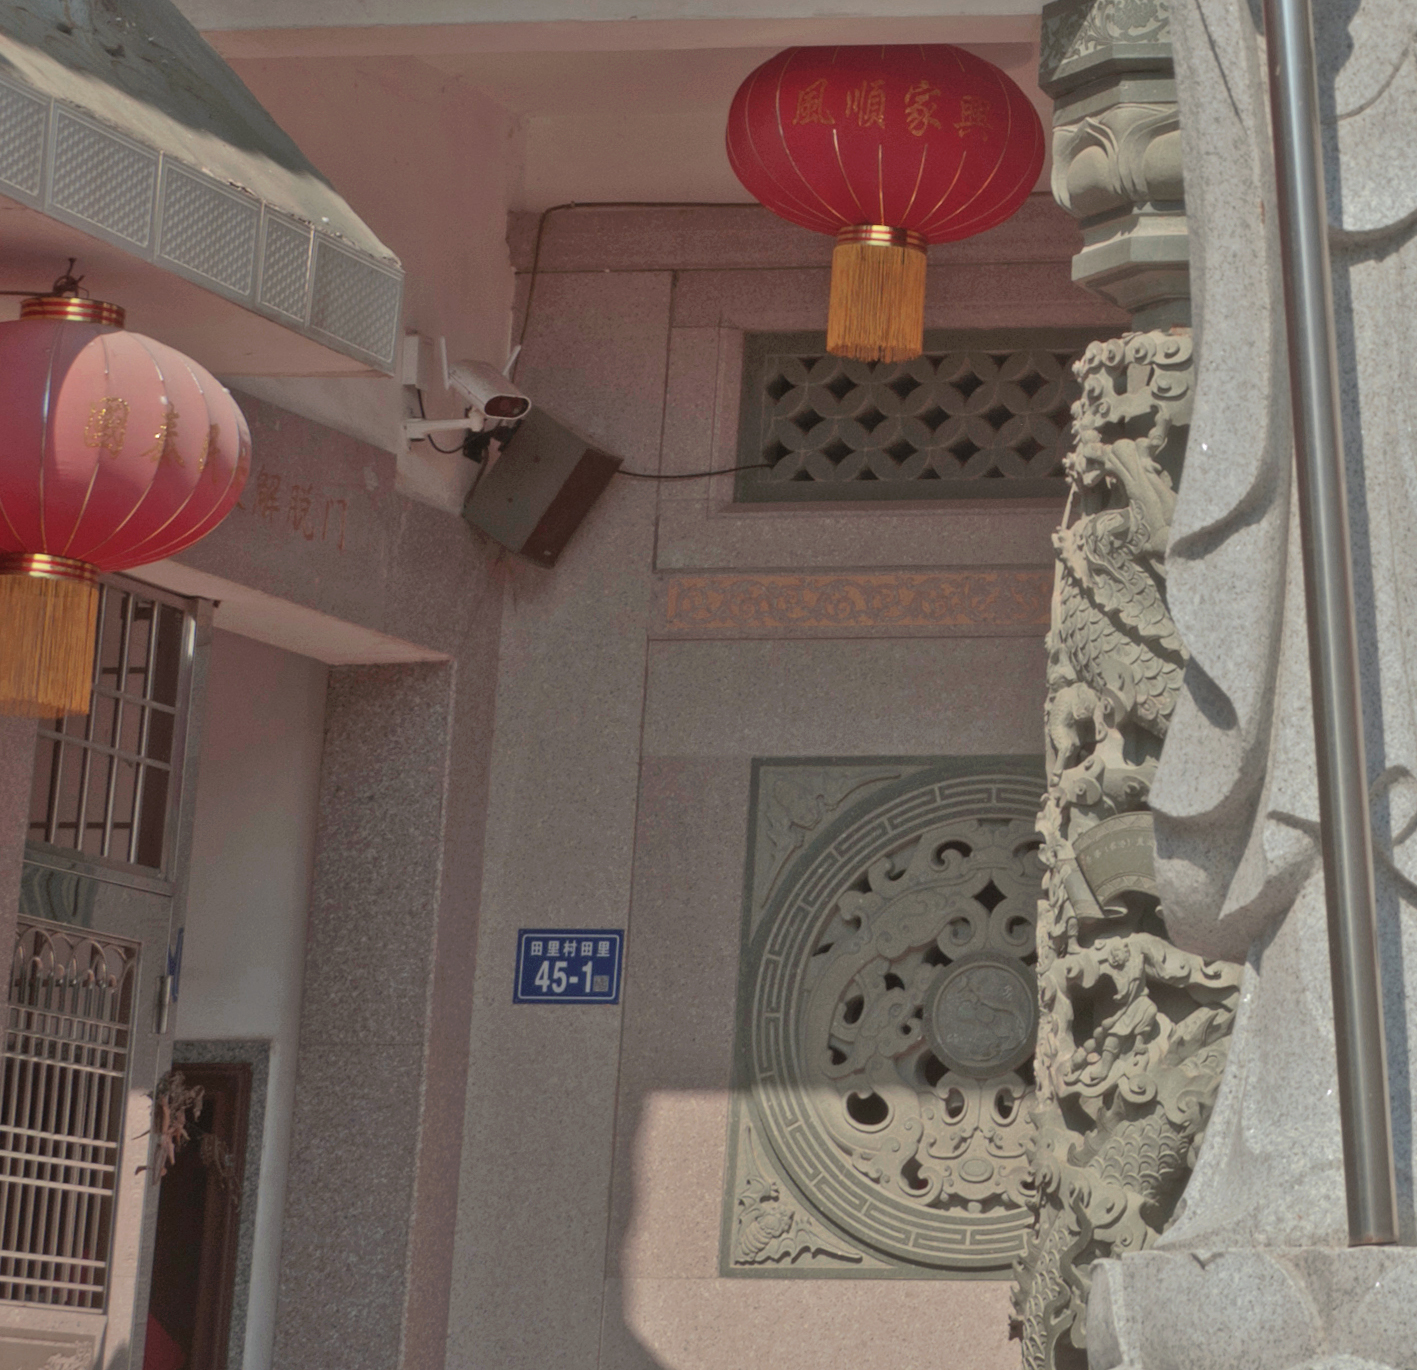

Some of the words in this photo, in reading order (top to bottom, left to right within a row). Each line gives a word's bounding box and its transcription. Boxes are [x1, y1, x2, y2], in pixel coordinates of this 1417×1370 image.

[792, 78, 994, 142] 風順家興
[530, 940, 611, 957] 田里村田里
[534, 960, 593, 993] 45-1
